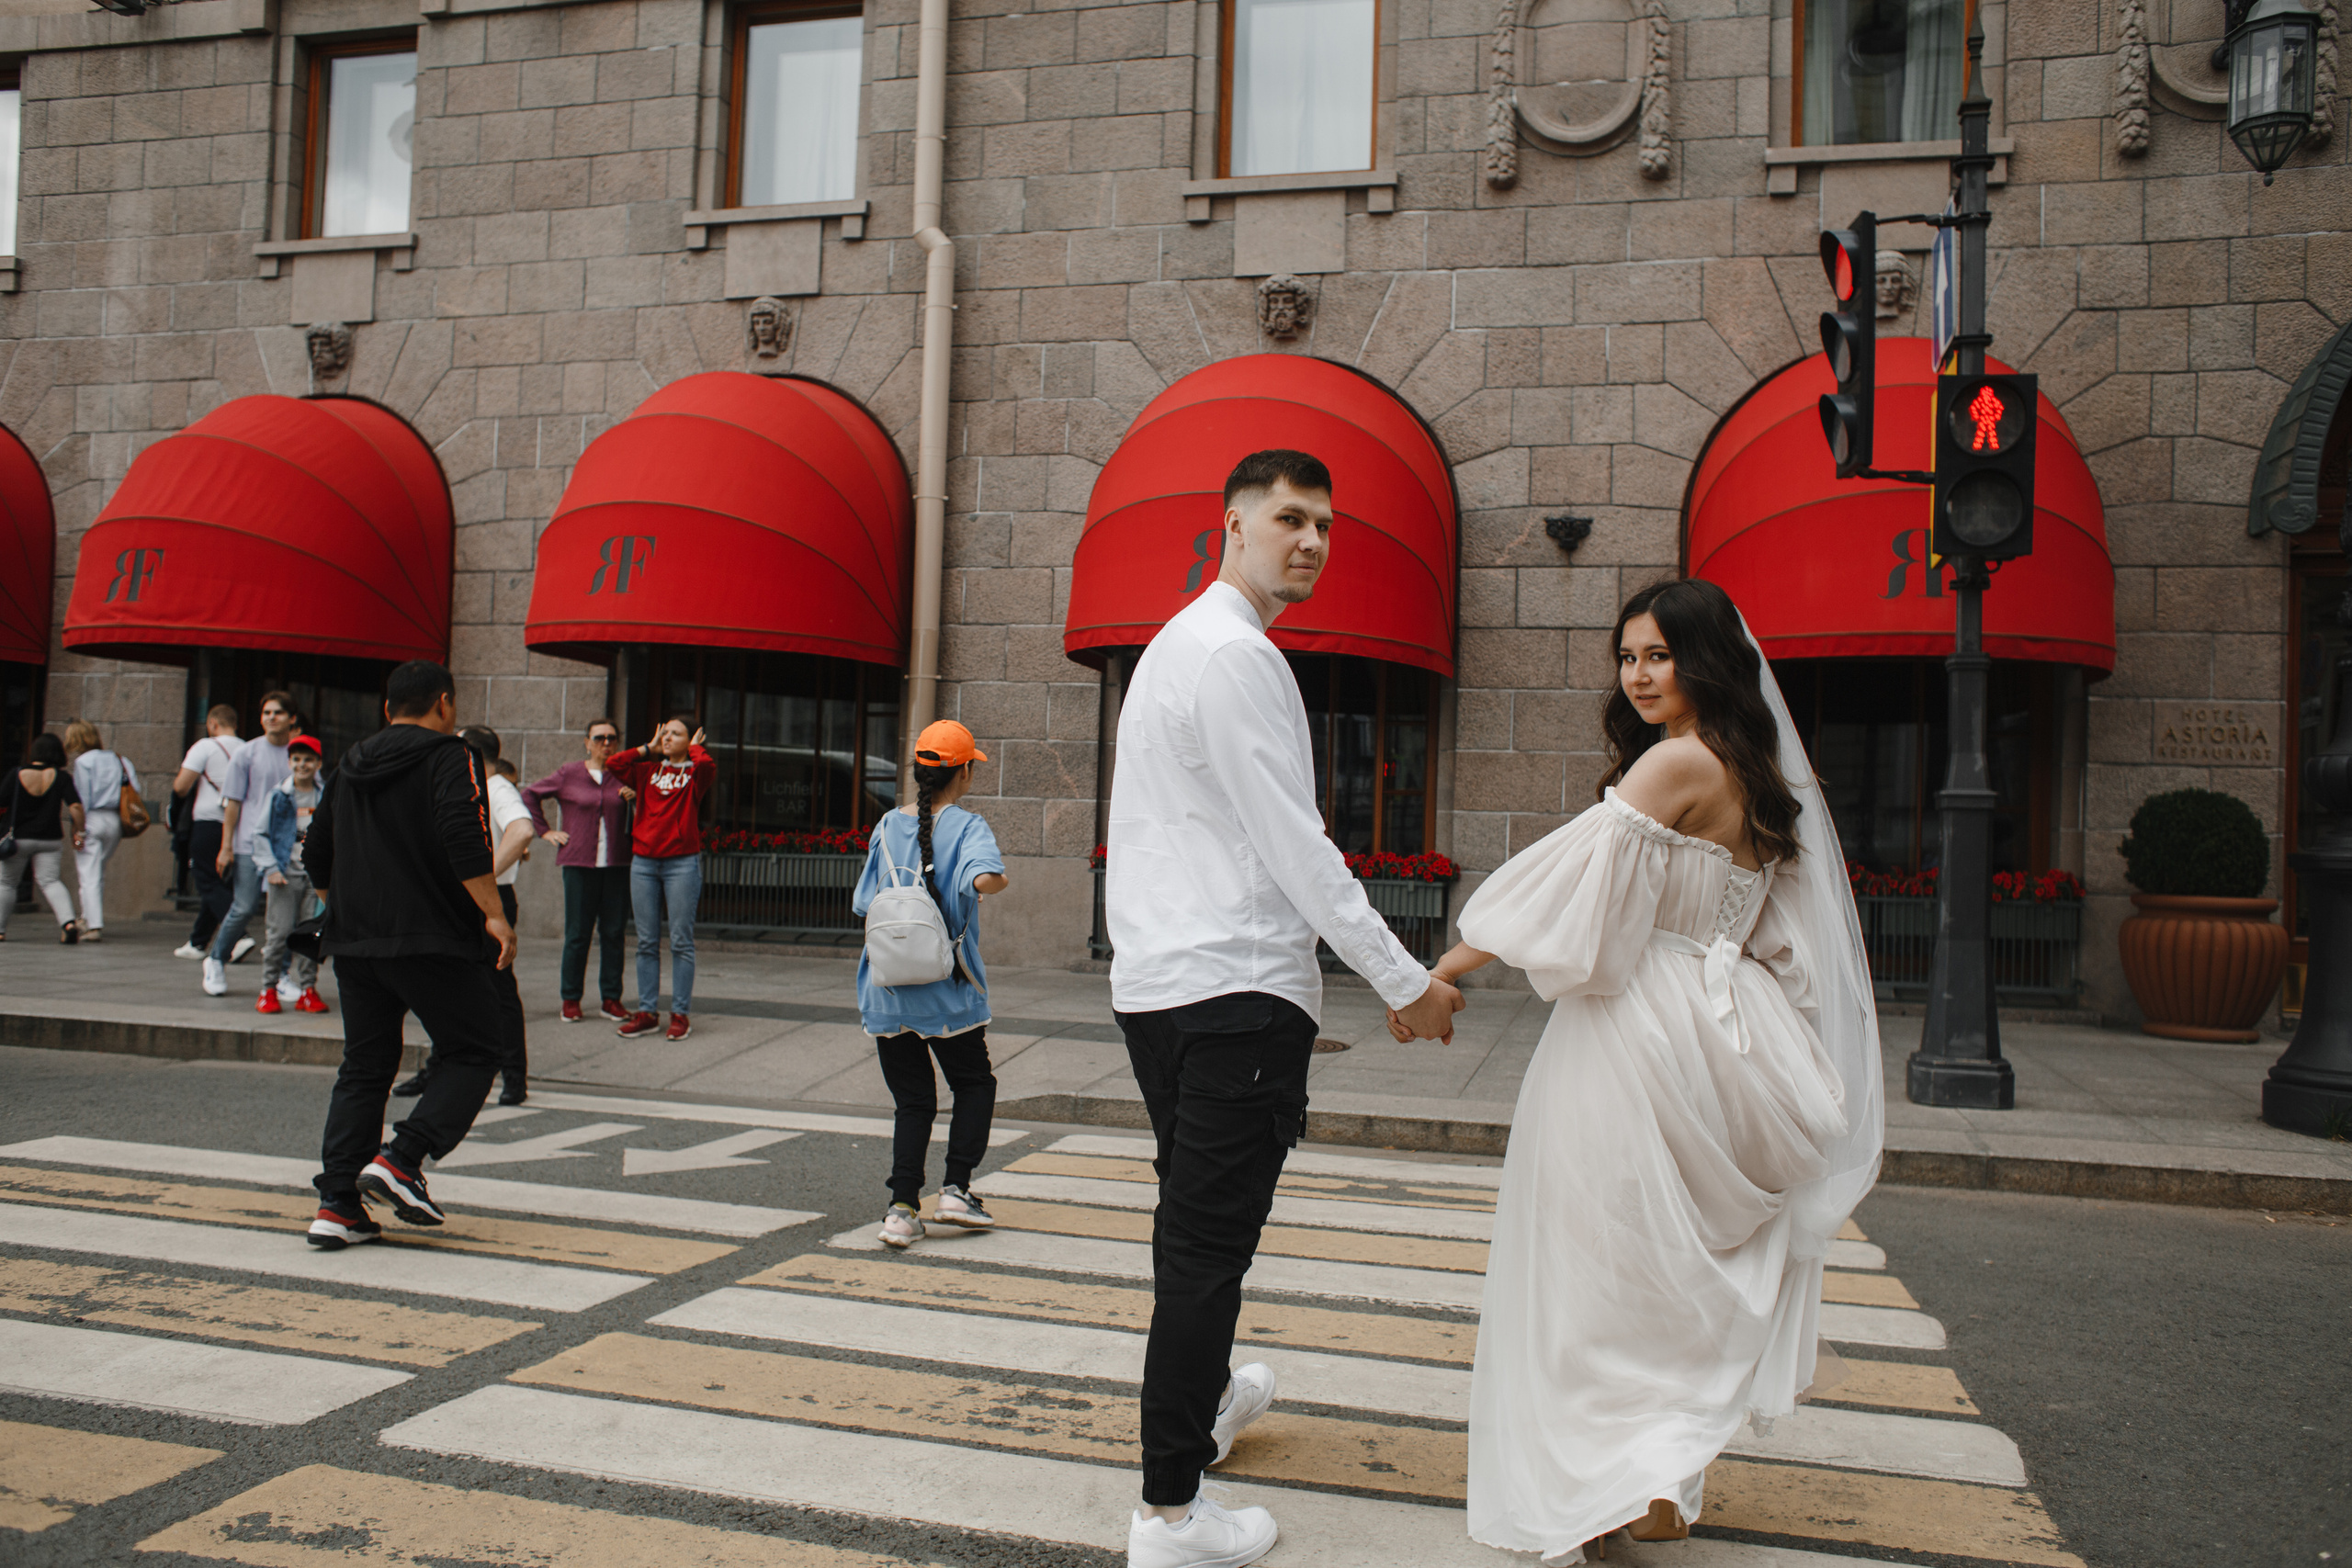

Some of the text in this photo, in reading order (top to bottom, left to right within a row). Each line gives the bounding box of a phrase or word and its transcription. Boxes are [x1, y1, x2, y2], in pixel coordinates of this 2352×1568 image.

[2182, 707, 2246, 724] HOTEL
[2163, 724, 2268, 745] ASTORIA
[2158, 745, 2272, 761] RESTAURANT
[776, 798, 808, 815] BAR
